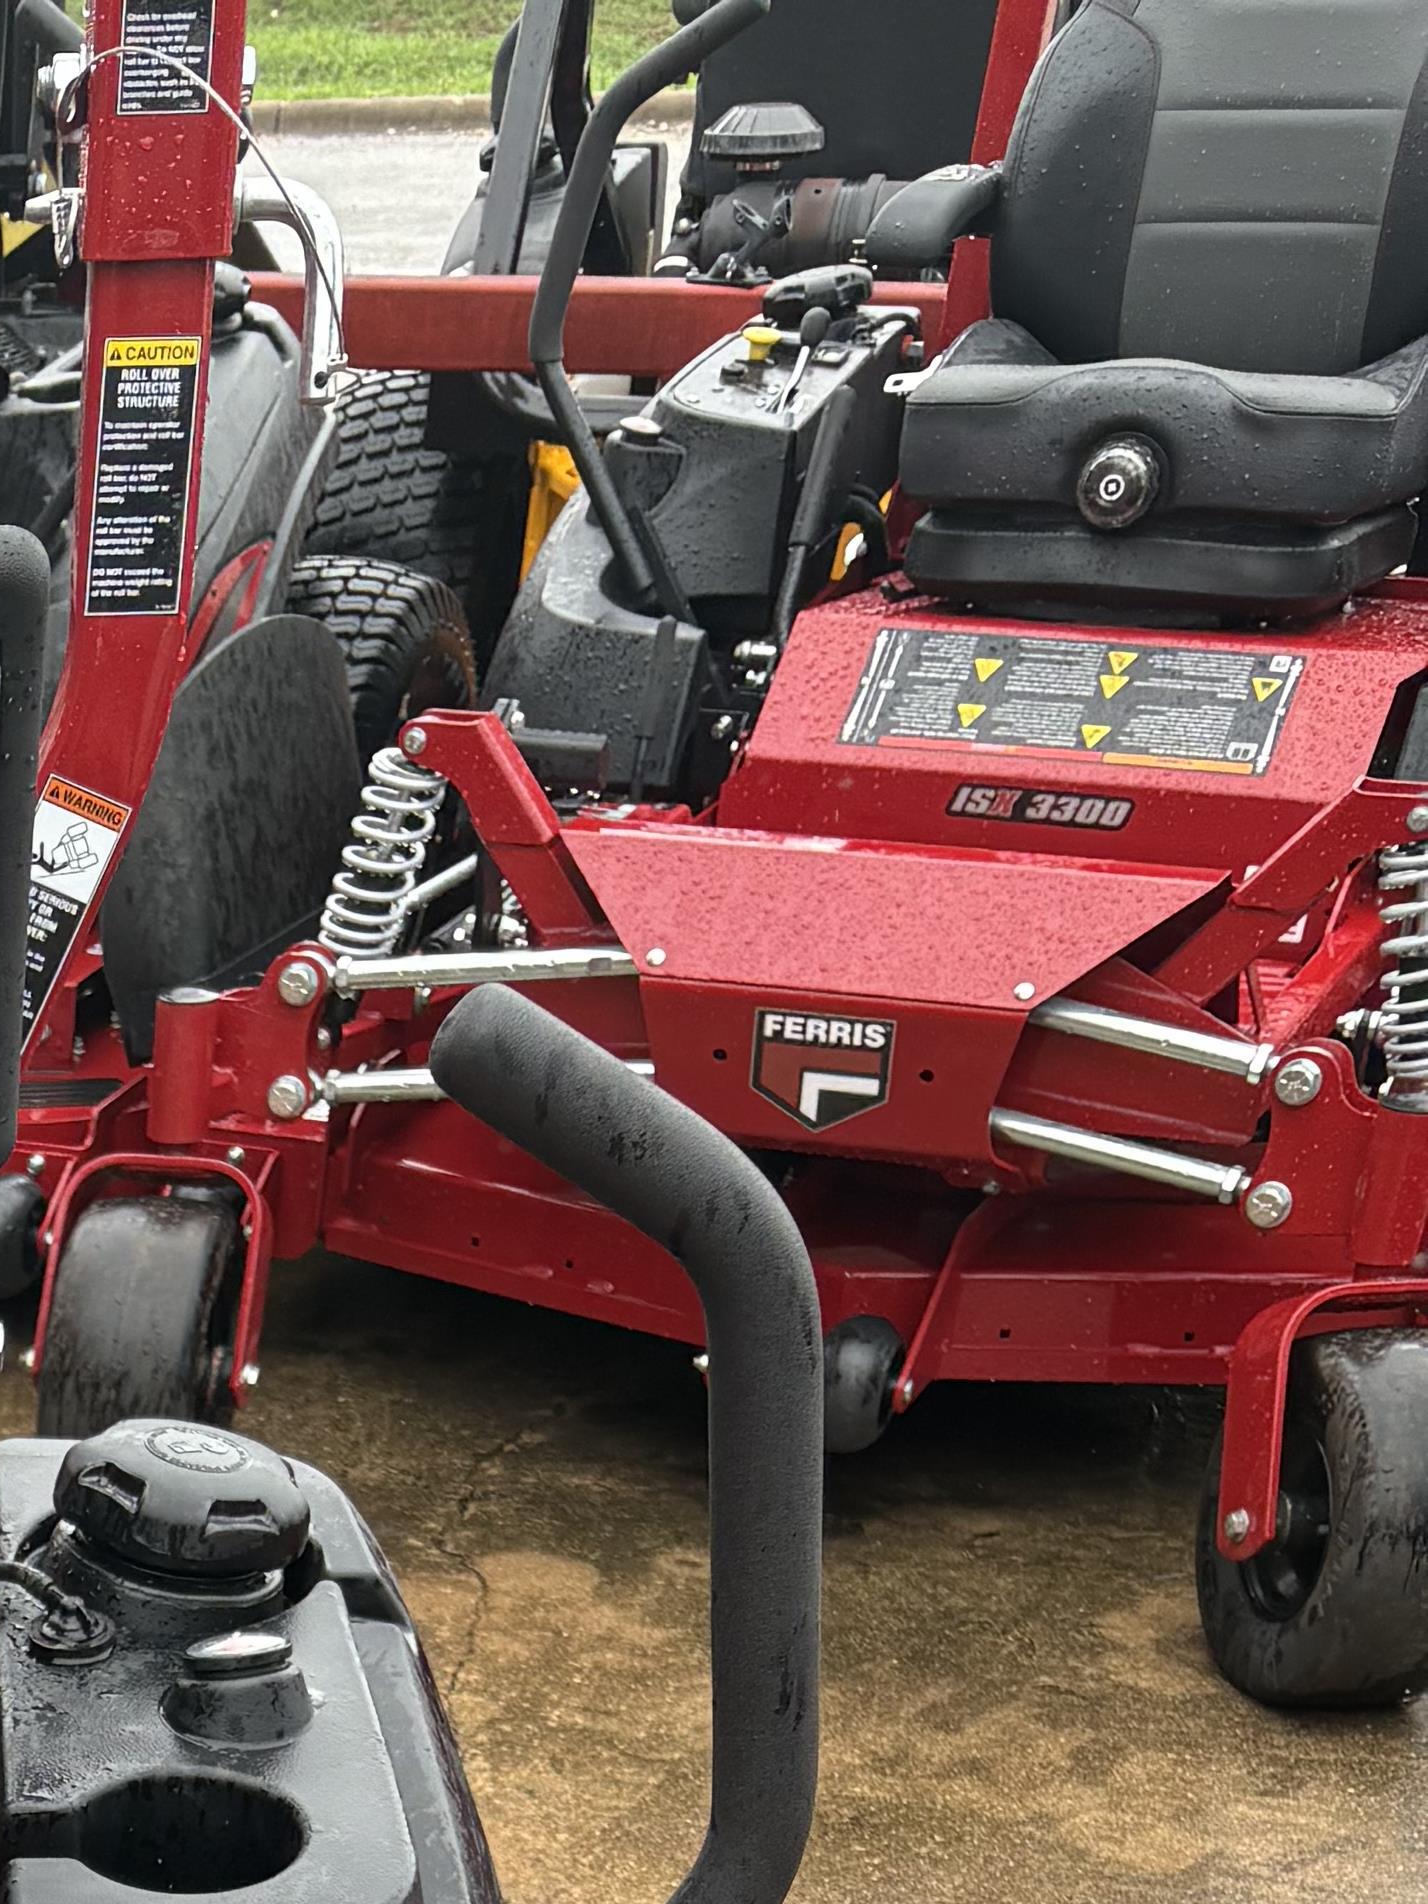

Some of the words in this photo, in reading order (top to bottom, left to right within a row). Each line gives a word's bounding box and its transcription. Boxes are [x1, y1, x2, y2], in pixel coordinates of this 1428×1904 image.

[126, 346, 194, 360] CAUTION
[121, 369, 148, 380] ROLL
[151, 368, 179, 379] OVER
[117, 382, 181, 394] PROTECTIVE
[117, 396, 179, 408] STRUCTURE
[63, 791, 122, 825] WARNING
[950, 786, 1023, 817] ISX
[1025, 794, 1132, 826] 3300
[763, 1014, 887, 1048] FERRIS
